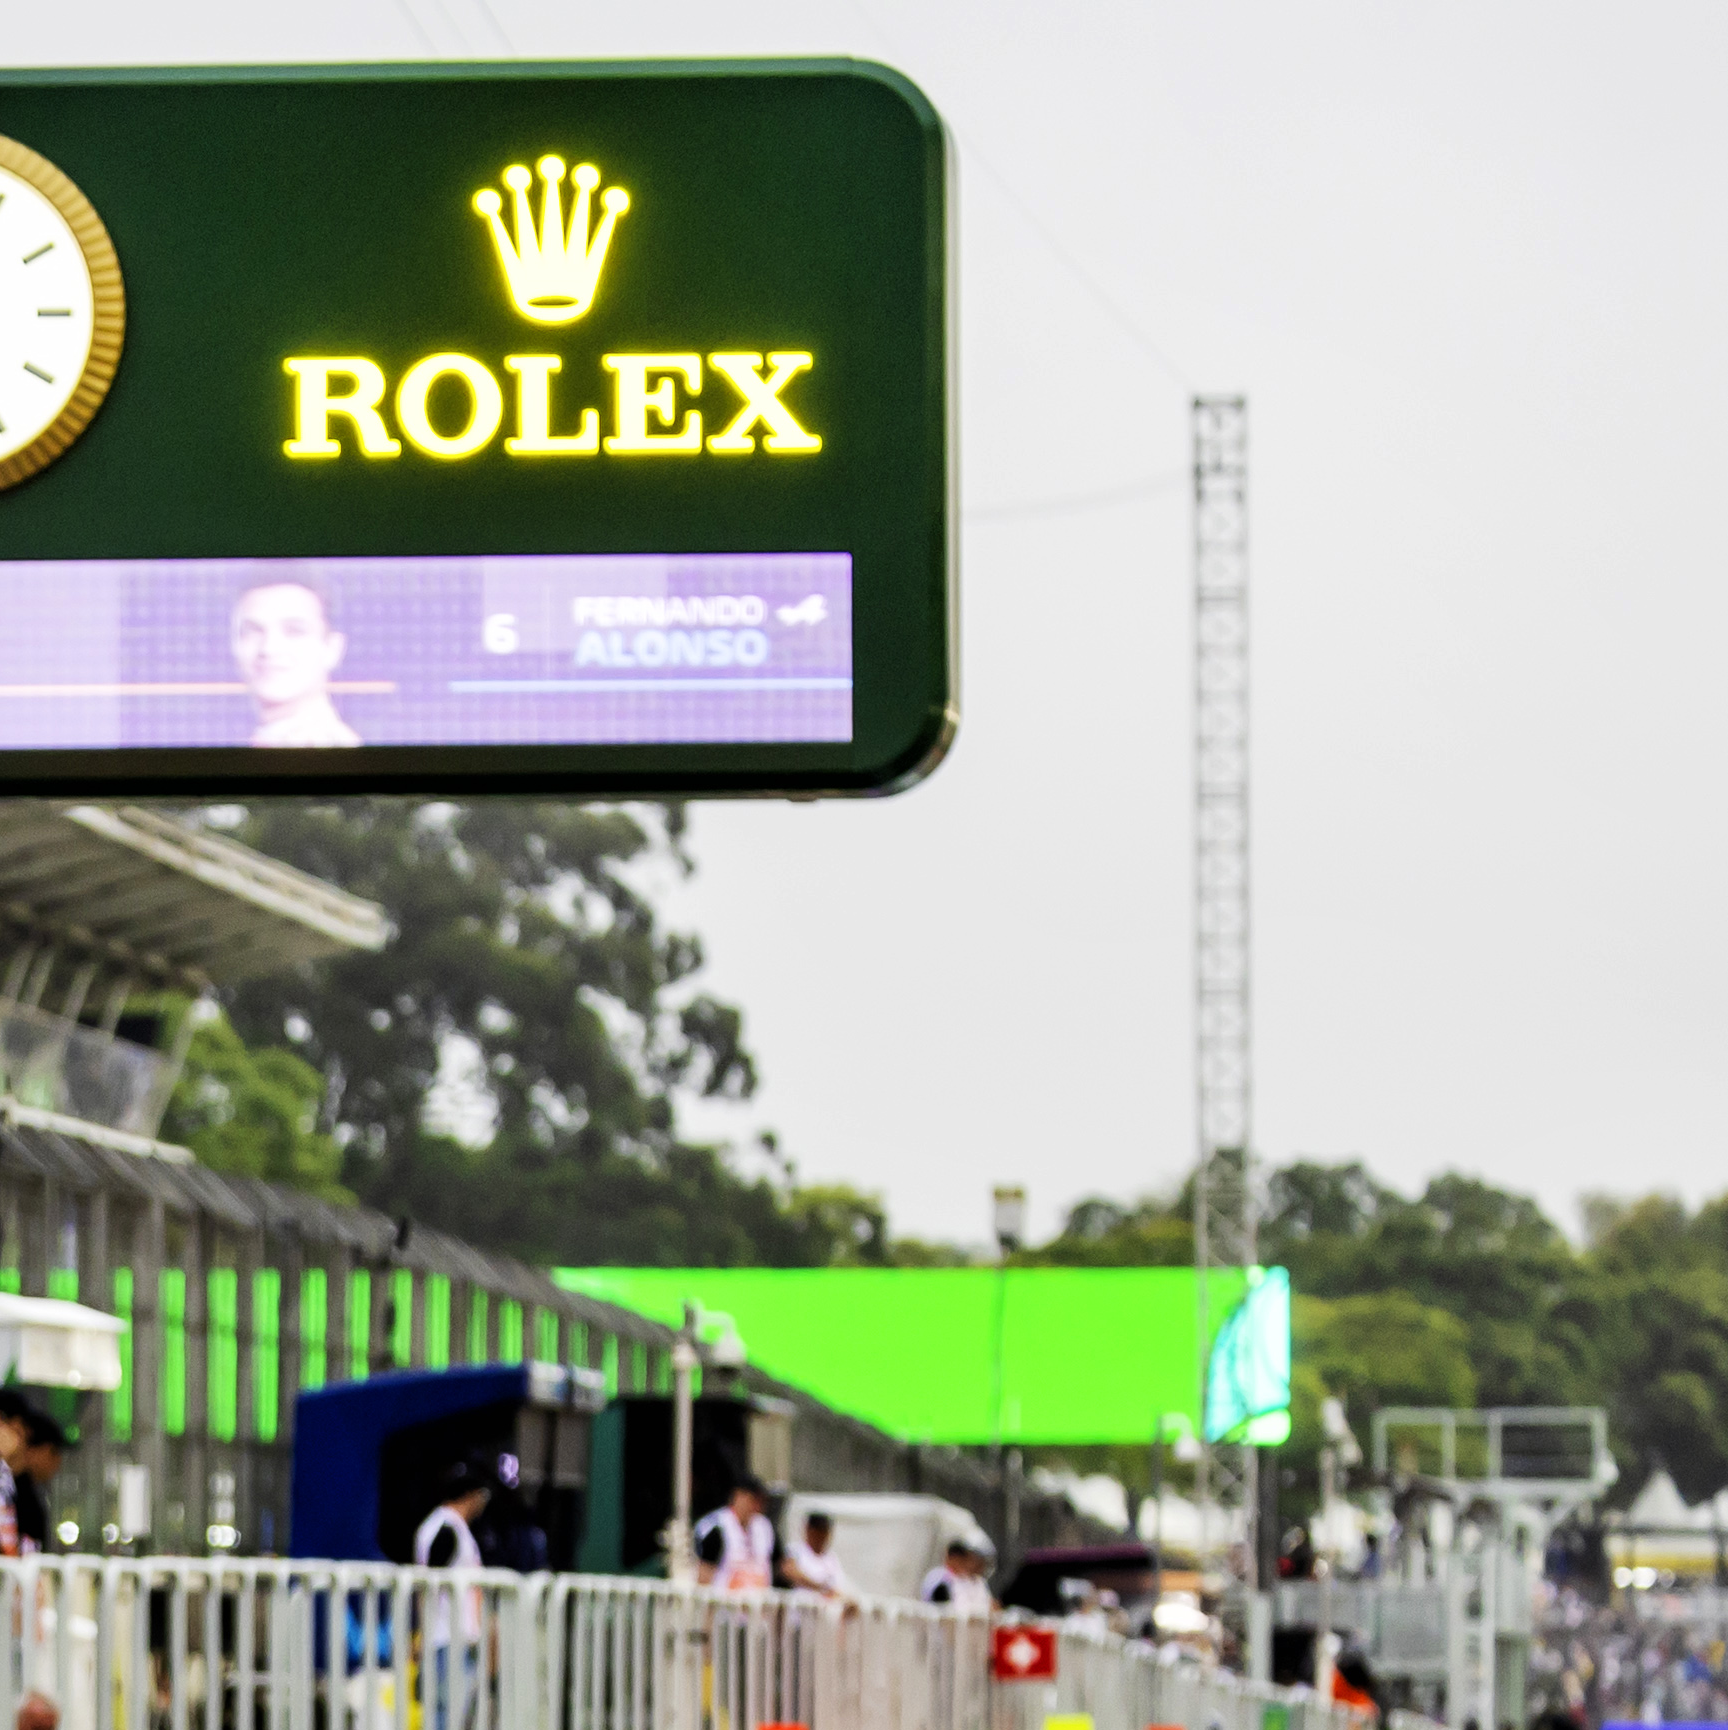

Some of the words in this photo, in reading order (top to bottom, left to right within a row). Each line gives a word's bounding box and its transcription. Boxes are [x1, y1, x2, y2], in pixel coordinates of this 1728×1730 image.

[282, 352, 823, 457] ROLEX
[573, 596, 765, 626] FERNANDO
[483, 614, 518, 653] 6
[574, 630, 770, 668] ALONSO
